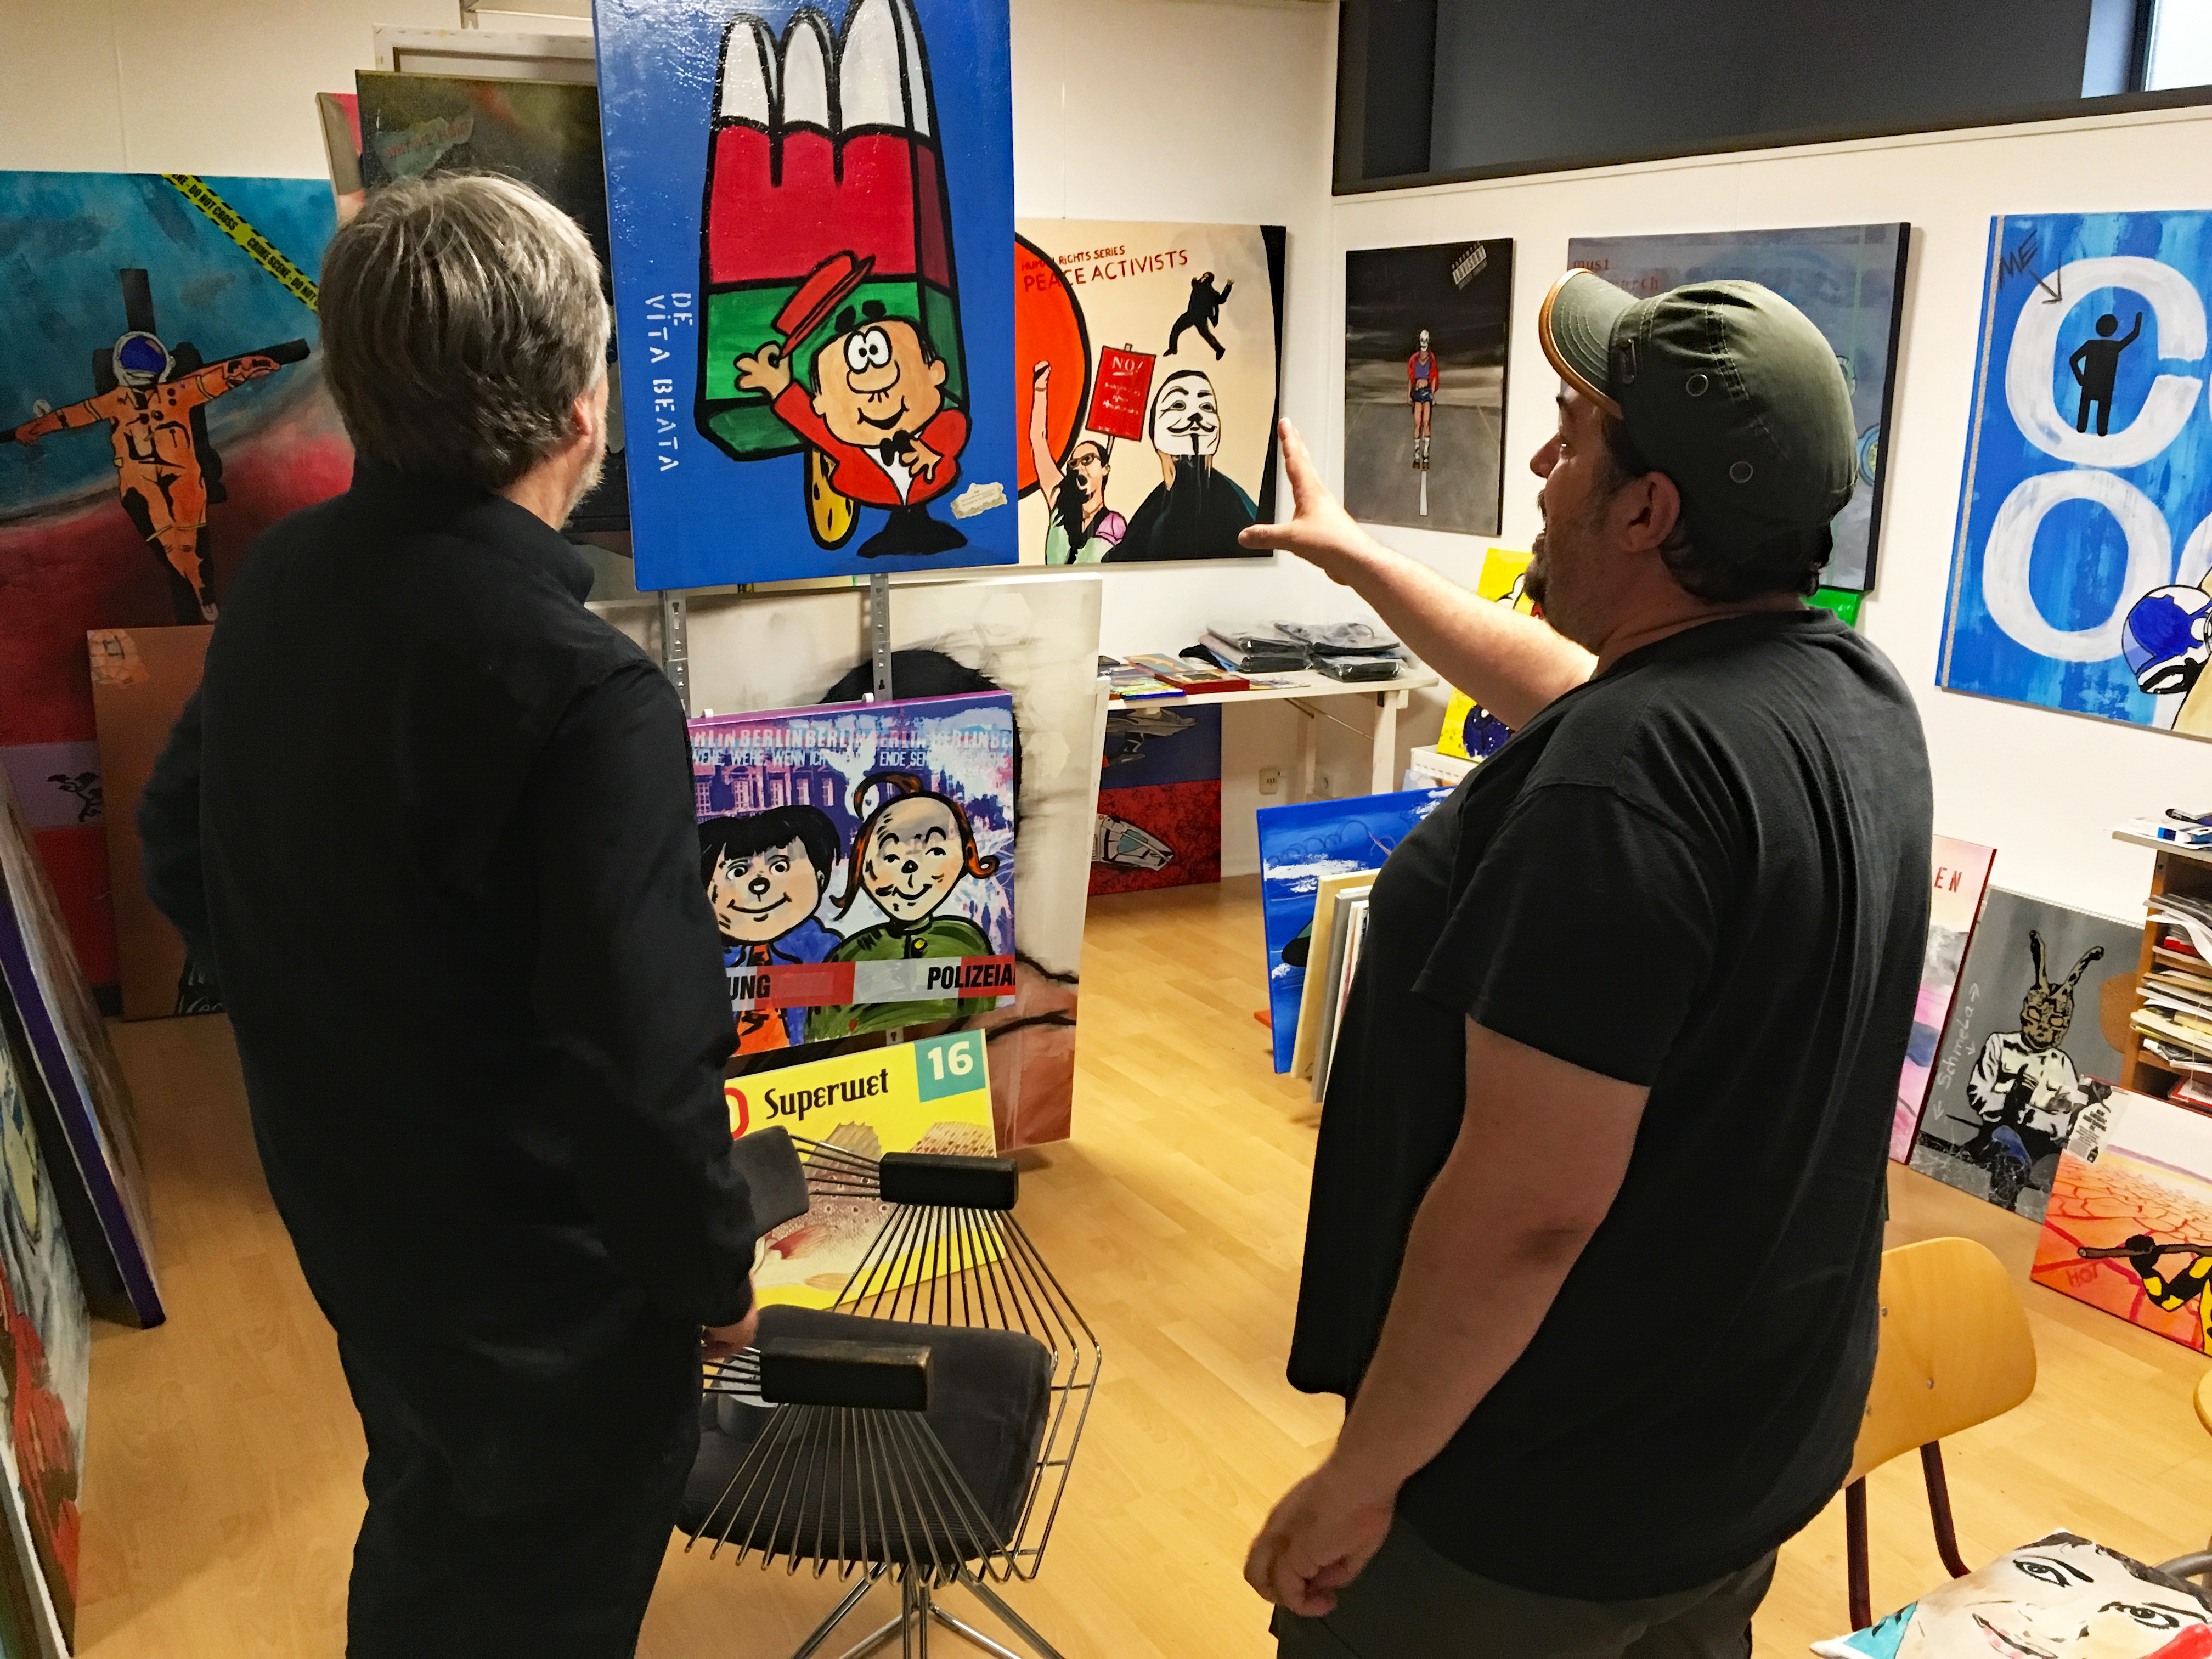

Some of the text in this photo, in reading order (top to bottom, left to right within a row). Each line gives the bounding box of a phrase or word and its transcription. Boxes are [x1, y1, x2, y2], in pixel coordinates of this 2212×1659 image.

[188, 184, 201, 198] DO
[198, 193, 216, 210] NOT
[212, 206, 238, 231] CROSS
[247, 237, 271, 261] CRIME
[267, 255, 291, 279] SCENE
[290, 277, 303, 290] DO
[1091, 249, 1188, 281] ACTIVISTS
[1998, 229, 2038, 290] ME
[671, 292, 693, 326] DE
[1111, 356, 1144, 374] NO!
[652, 379, 679, 472] BEATA
[879, 751, 907, 768] ENDE
[1934, 866, 1962, 893] EN
[727, 963, 1016, 1001] UNG POLIZEIA
[764, 1068, 889, 1121] Superwet
[927, 1041, 974, 1081] 16
